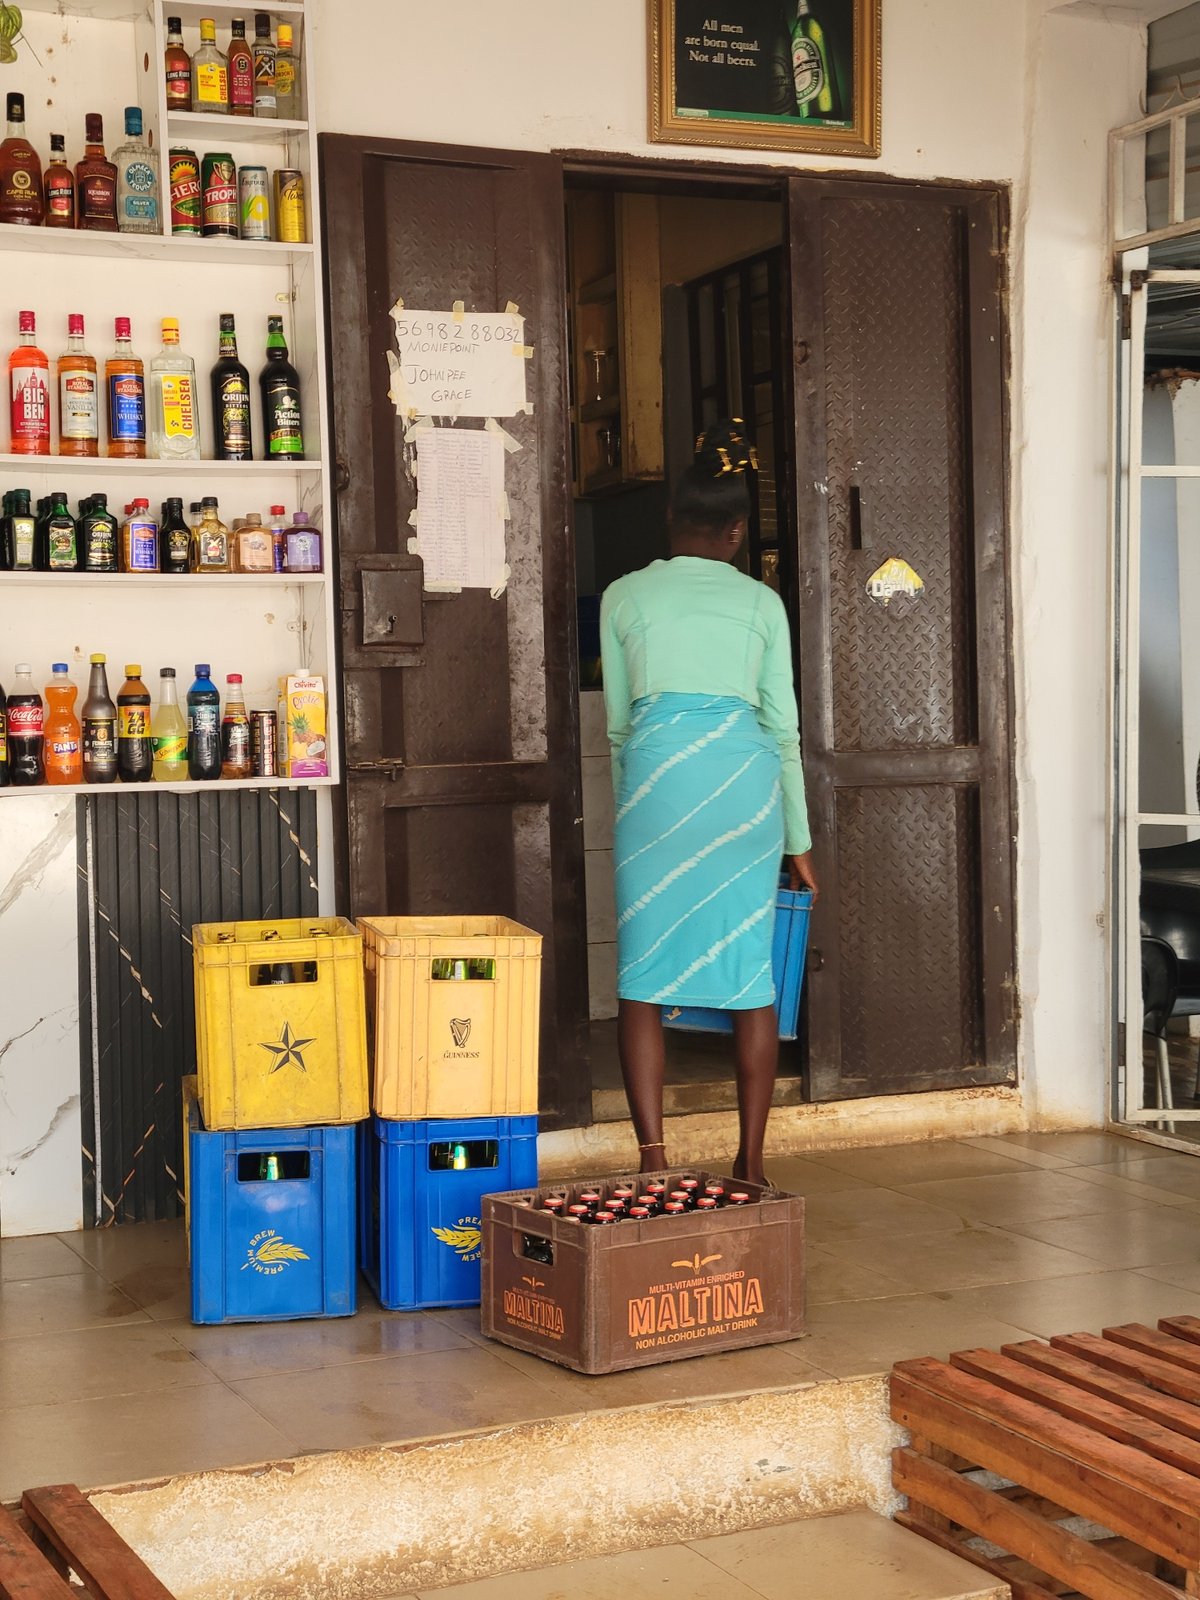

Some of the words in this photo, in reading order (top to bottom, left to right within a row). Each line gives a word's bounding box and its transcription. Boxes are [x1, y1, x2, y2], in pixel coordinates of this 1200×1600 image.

[702, 19, 718, 31] All
[720, 24, 744, 34] men
[684, 36, 701, 46] are
[703, 35, 728, 48] born
[689, 49, 709, 62] Not
[711, 52, 725, 64] all
[219, 70, 227, 101] CHELSEA
[128, 164, 151, 175] OLMECA
[129, 180, 152, 191] TEQUILA
[23, 387, 44, 403] BIG
[222, 393, 249, 403] ORIJIN
[431, 389, 472, 403] GRACE
[24, 403, 45, 420] BEN
[179, 379, 193, 430] CHELSEA
[117, 413, 143, 421] WHISKY
[294, 680, 317, 689] Chivita
[443, 1050, 480, 1059] GUINNESS
[249, 1229, 275, 1247] BREW
[247, 1249, 284, 1275] PREMIUM
[462, 1250, 482, 1262] REW
[649, 1278, 705, 1294] MULTI-VITAMIN
[707, 1270, 745, 1284] ENRICHED
[504, 1290, 564, 1334] MALTINA
[628, 1278, 764, 1337] MALTINA
[635, 1338, 655, 1350] NON
[657, 1328, 706, 1345] ALCOHOLIC
[707, 1323, 730, 1337] MALT
[731, 1317, 758, 1331] DRINK
